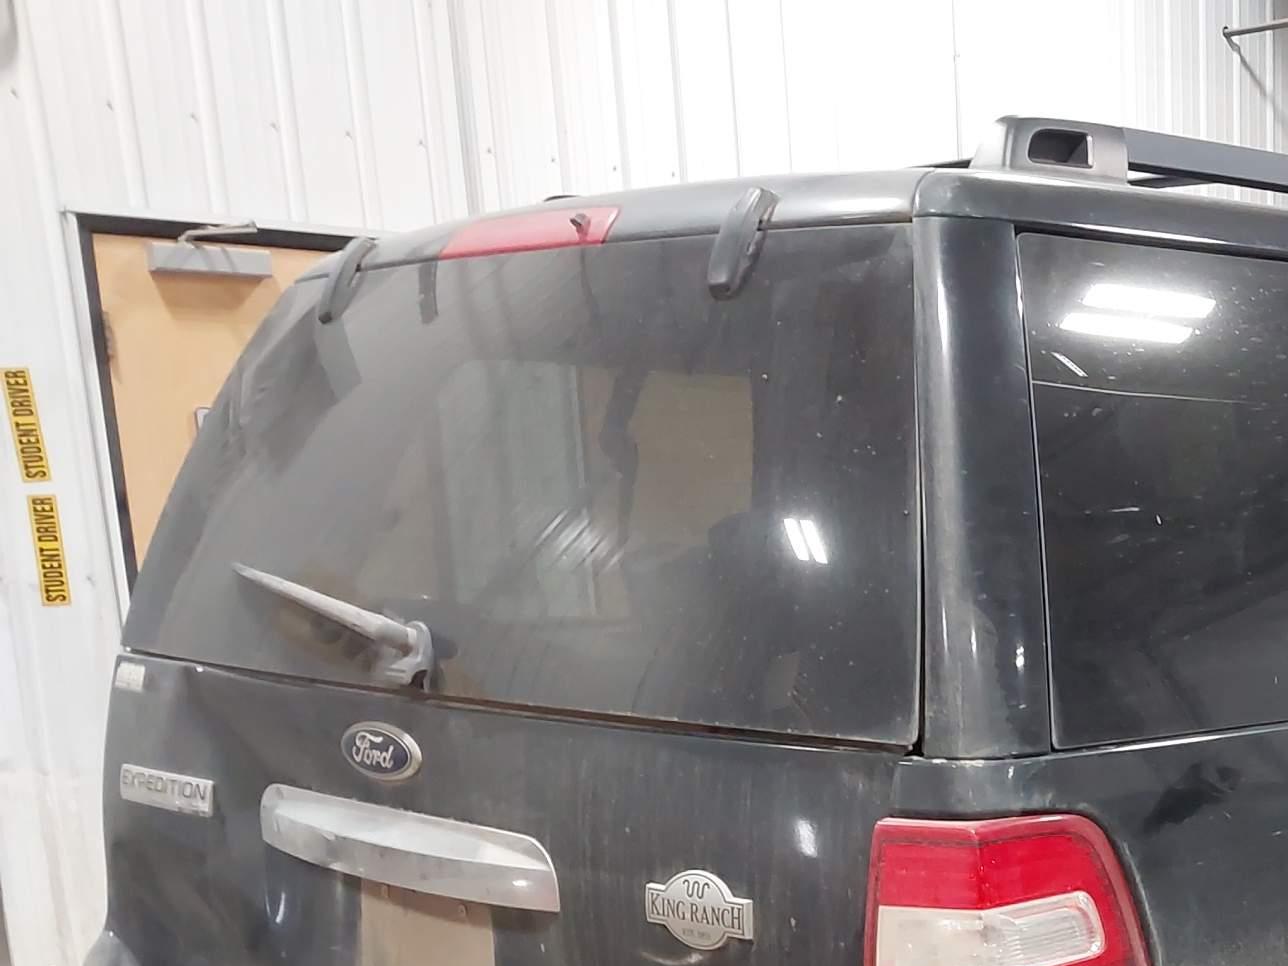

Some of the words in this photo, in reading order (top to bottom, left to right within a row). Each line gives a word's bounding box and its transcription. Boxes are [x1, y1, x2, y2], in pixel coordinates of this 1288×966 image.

[5, 370, 34, 418] DRIVER
[16, 421, 47, 480] STUDENT
[32, 497, 58, 543] DRIVER
[41, 546, 67, 603] STUDENT
[352, 732, 395, 769] Ford
[121, 768, 208, 801] EXPEDITION
[650, 893, 685, 920] KING
[690, 903, 741, 930] RANCH
